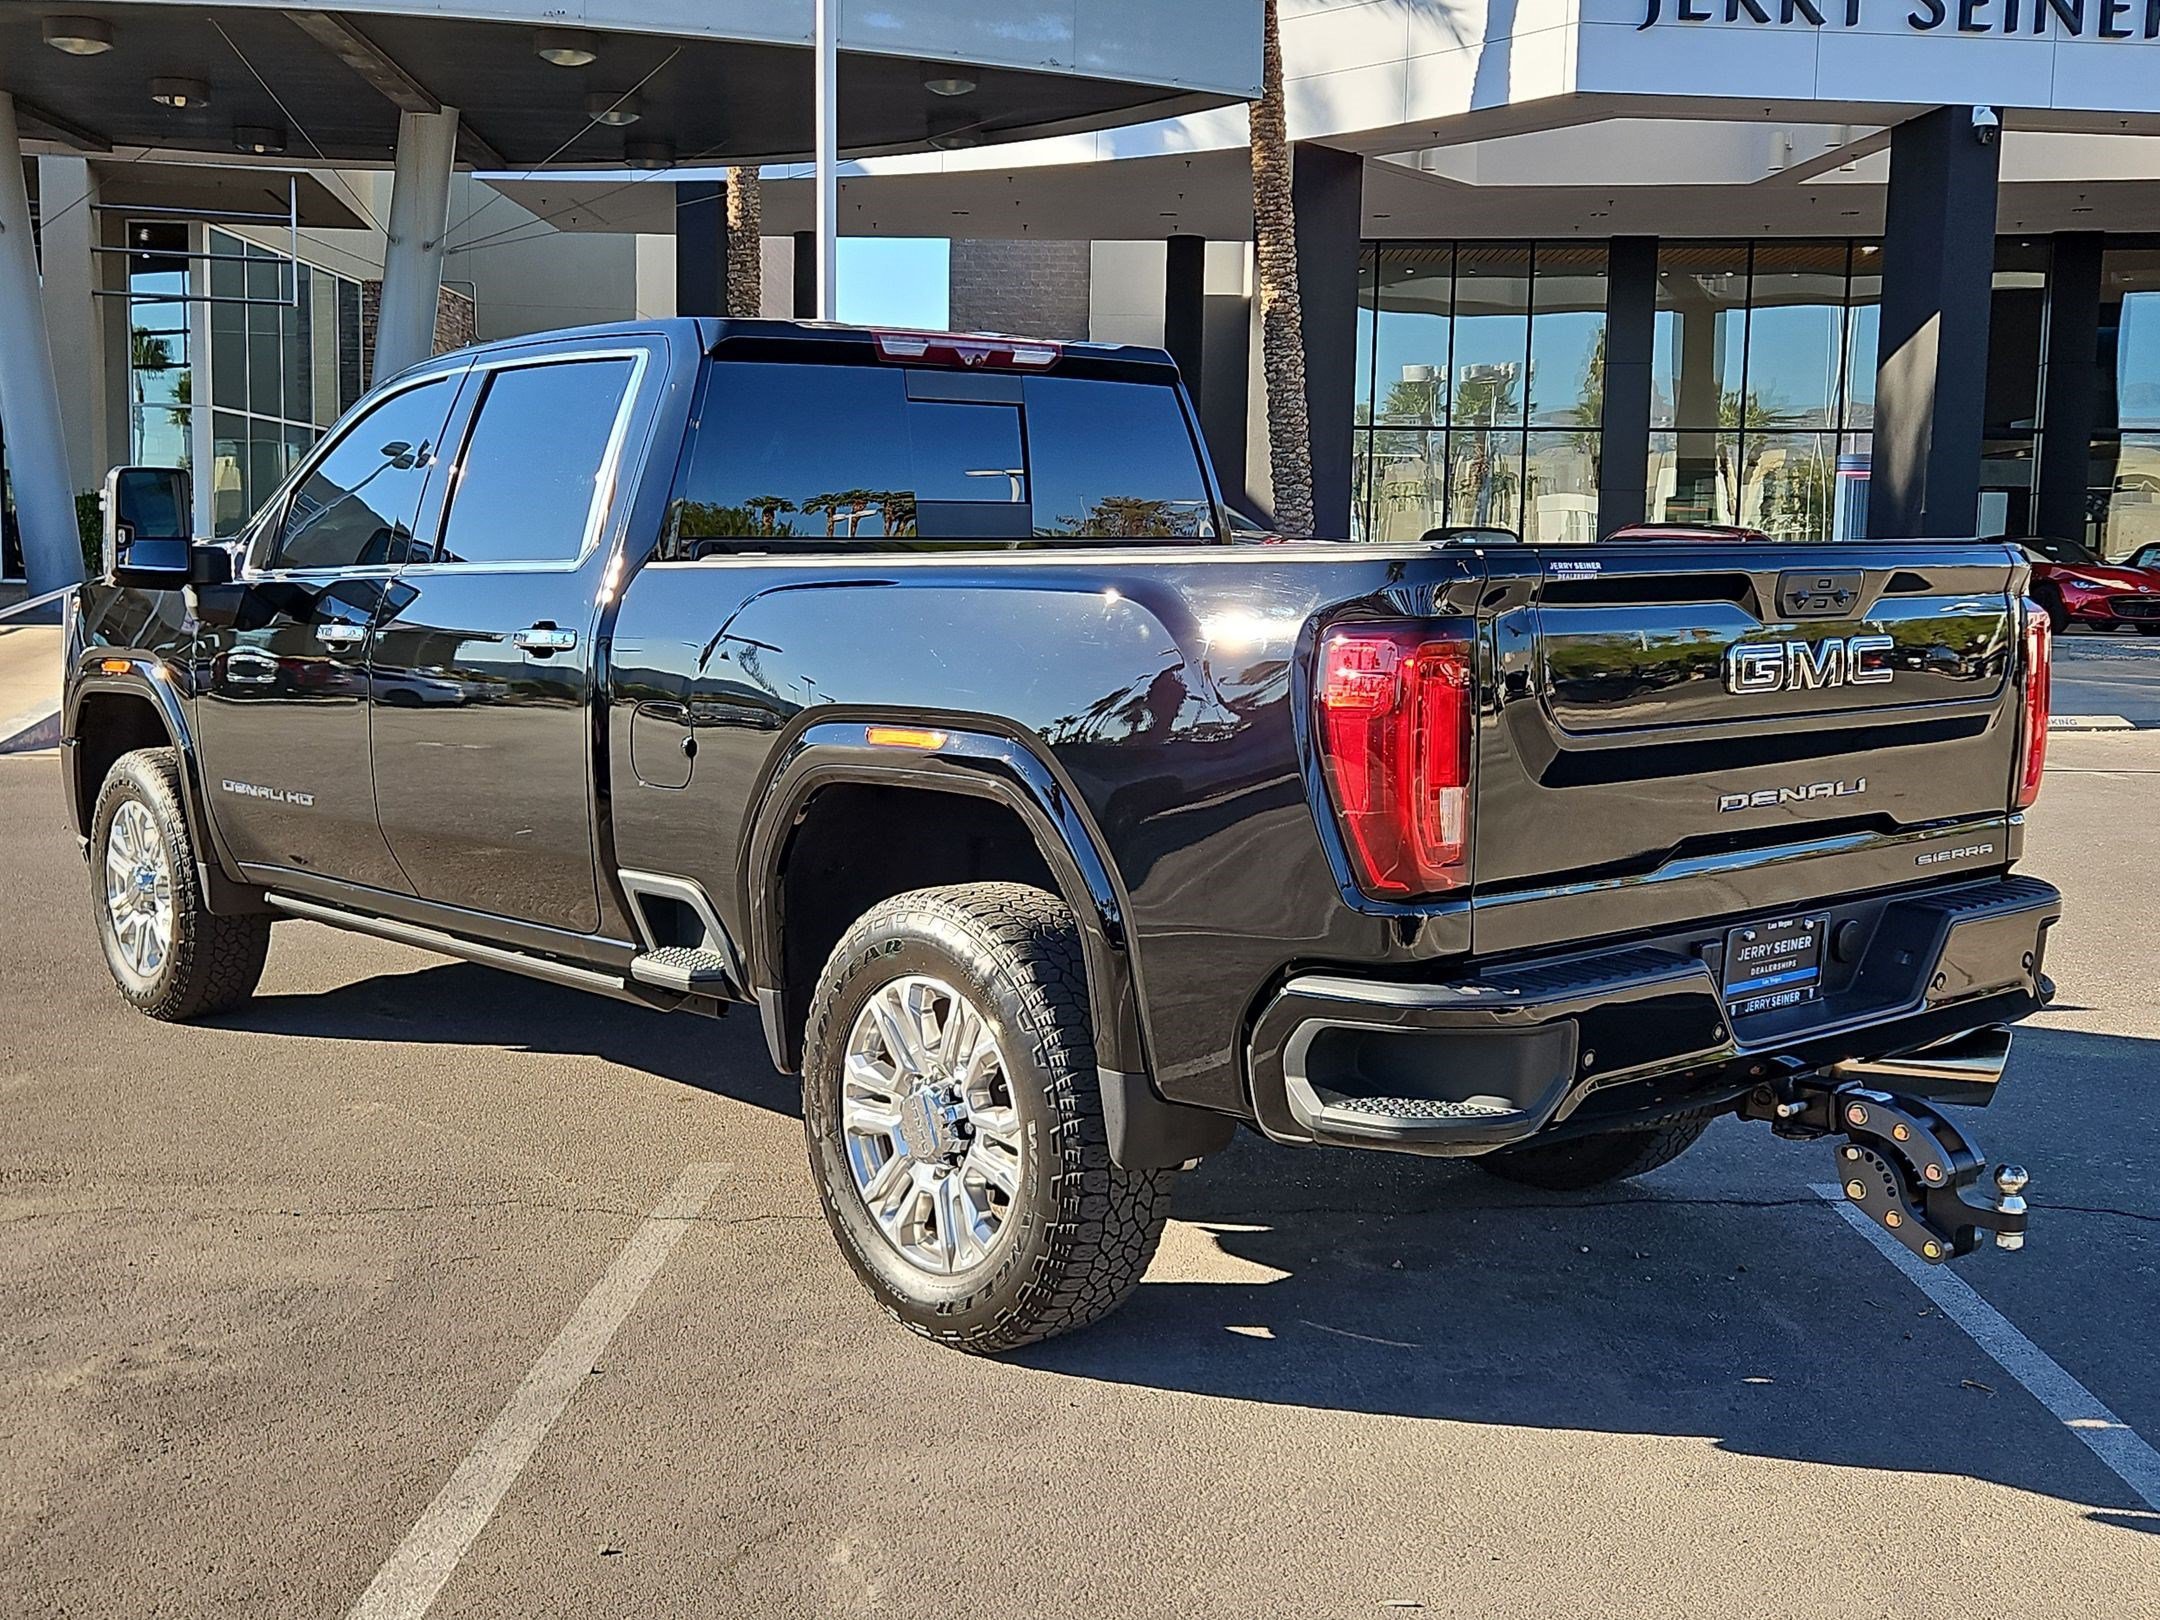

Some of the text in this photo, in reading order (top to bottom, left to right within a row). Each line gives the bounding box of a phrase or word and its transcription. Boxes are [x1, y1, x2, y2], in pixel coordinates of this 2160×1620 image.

[1549, 561, 1602, 570] JERRY SEINER
[1727, 635, 1895, 695] GMC
[222, 779, 315, 806] DENALI HD
[1717, 777, 1868, 814] DENALI
[1916, 843, 1994, 865] SIERRA
[1767, 919, 1794, 930] Las Vegas
[1737, 935, 1812, 961] JERRY SEINER
[1750, 959, 1797, 976] DEALERSHIPS
[1744, 991, 1800, 1013] JERRY SEINER
